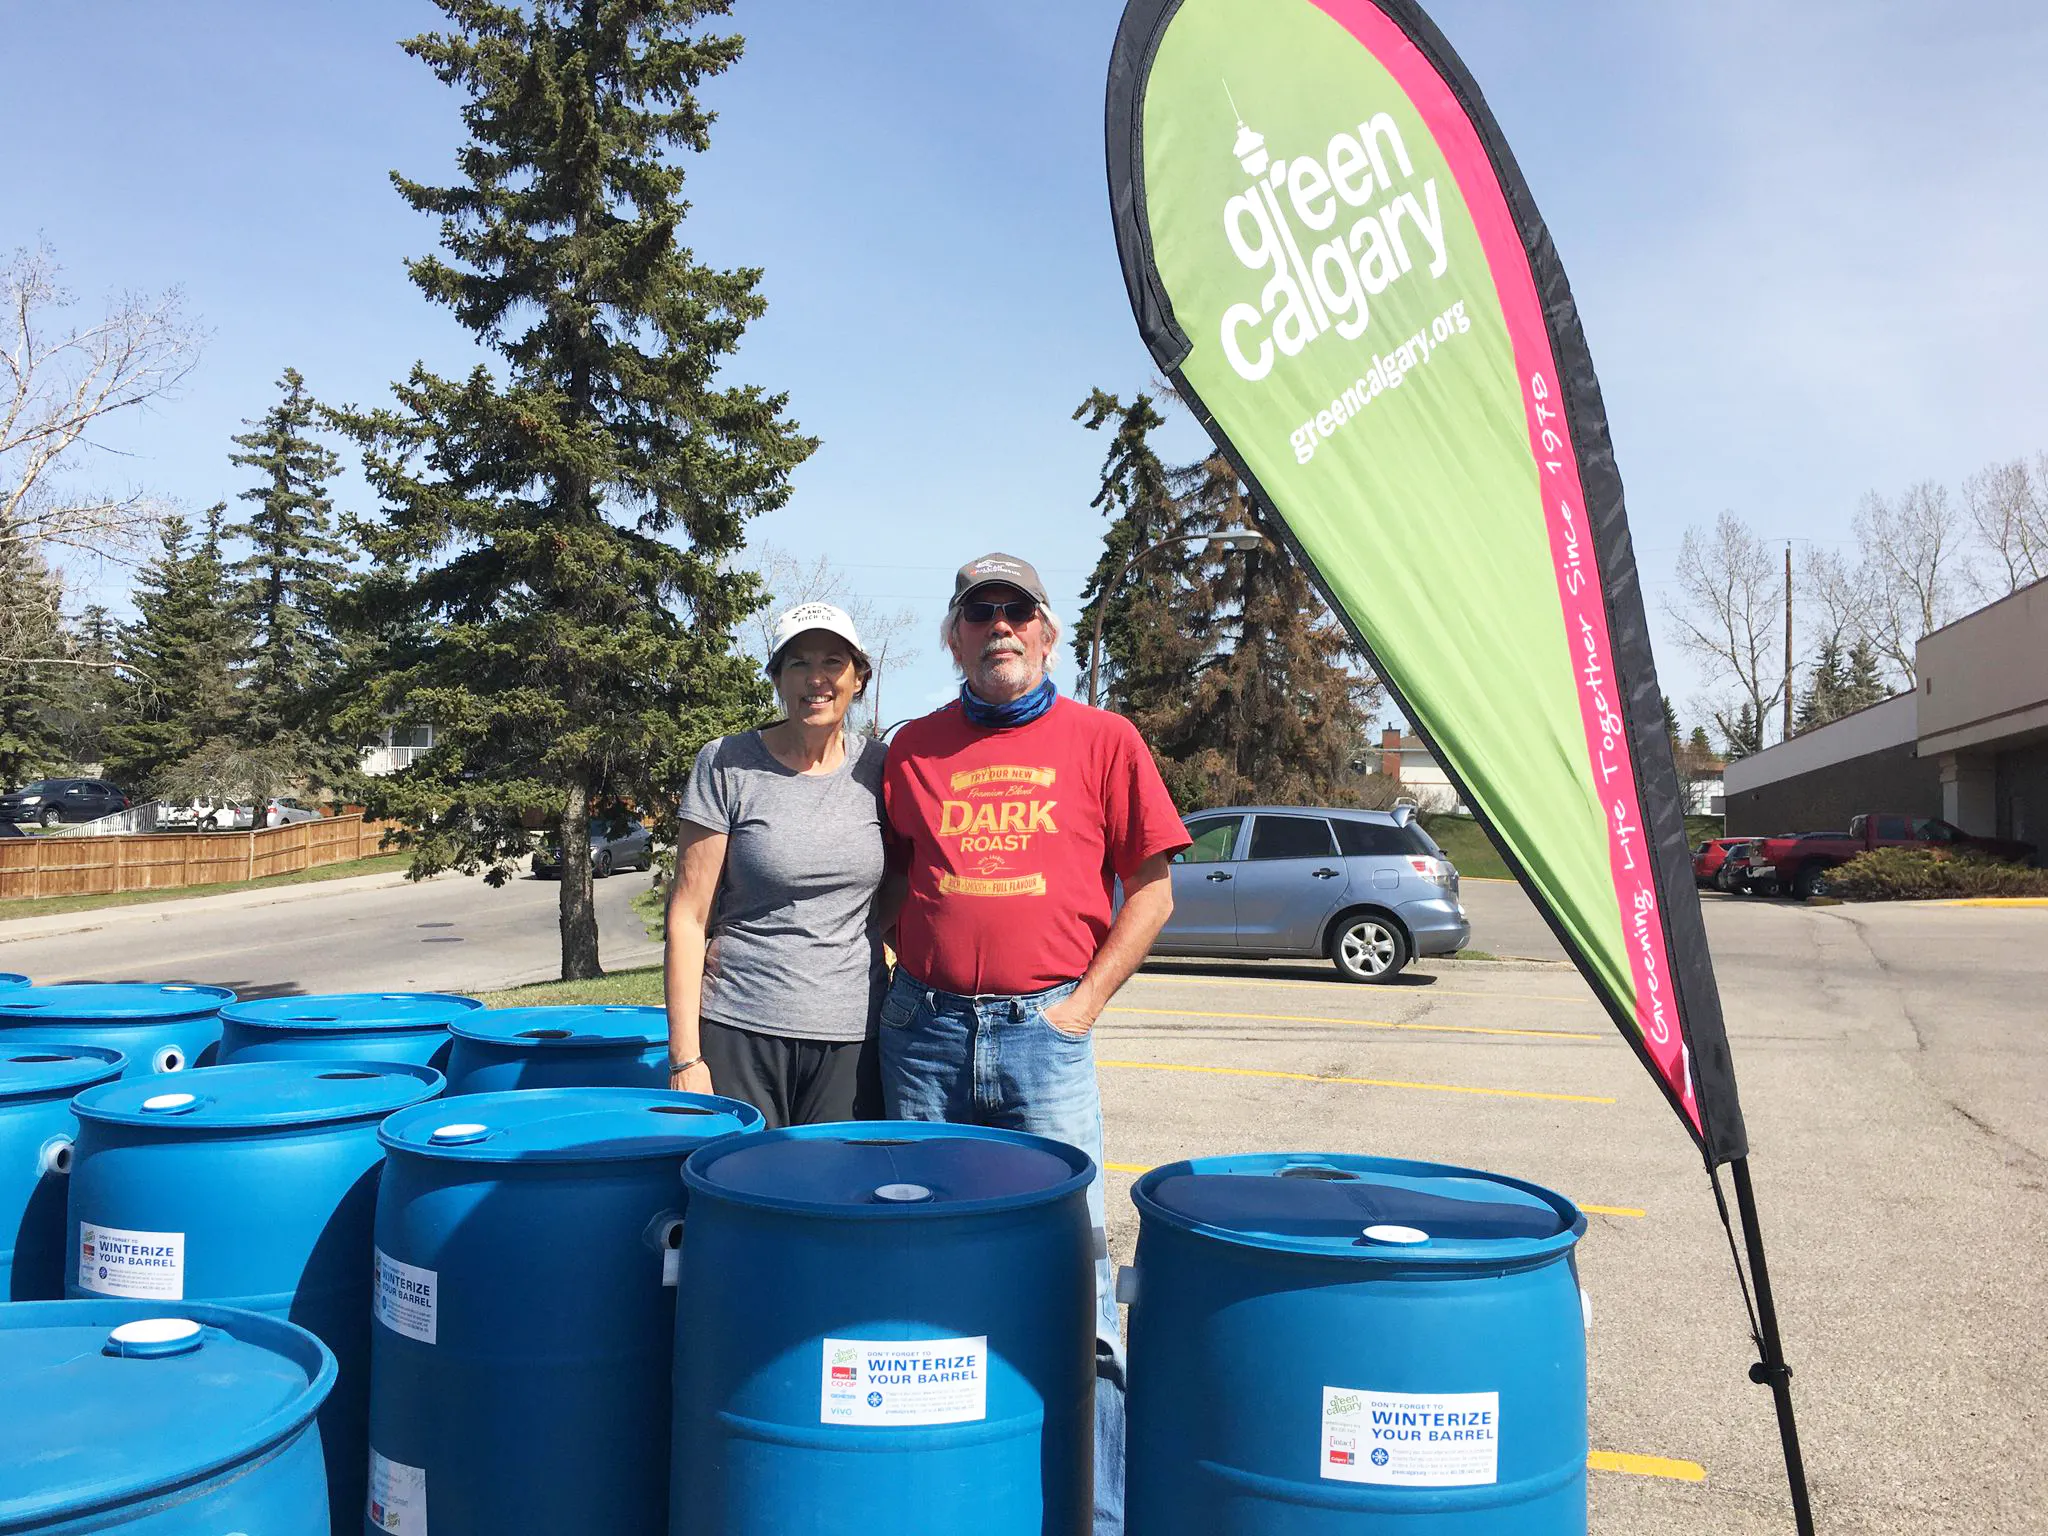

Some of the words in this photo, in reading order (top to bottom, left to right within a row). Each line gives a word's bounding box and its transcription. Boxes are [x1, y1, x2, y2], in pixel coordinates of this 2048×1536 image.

[1223, 111, 1414, 276] green
[1220, 177, 1448, 381] calgary
[1289, 299, 1471, 464] greencalgary.org
[1531, 371, 1563, 474] 1978
[1560, 500, 1586, 596] Since
[1579, 613, 1623, 784] Together
[971, 772, 987, 782] TRY
[989, 769, 1009, 780] OUR
[1012, 770, 1033, 779] NEW
[968, 787, 1004, 799] Premium
[1005, 785, 1037, 797] Blend
[938, 800, 1059, 836] DARK
[960, 834, 1031, 853] ROAST
[1613, 799, 1636, 870] Life
[992, 880, 1008, 893] FULL
[1009, 878, 1037, 891] FLAVOUR
[1634, 886, 1669, 1044] Greening
[99, 1241, 174, 1257] WINTERIZE
[99, 1253, 125, 1264] YOUR
[128, 1257, 176, 1268] BARREL
[382, 1267, 430, 1296] WINTERIZE
[382, 1282, 397, 1297] YOUR
[398, 1289, 432, 1308] BARREL
[867, 1355, 976, 1372] WINTERIZE
[867, 1374, 911, 1385] YOUR
[918, 1370, 978, 1384] BARREL
[1326, 1400, 1362, 1417] calgary
[1330, 1394, 1359, 1408] green
[1371, 1401, 1396, 1409] DON'T
[1371, 1410, 1492, 1427] WINTERIZE
[1372, 1428, 1421, 1441] YOUR
[1429, 1429, 1494, 1441] BARREL
